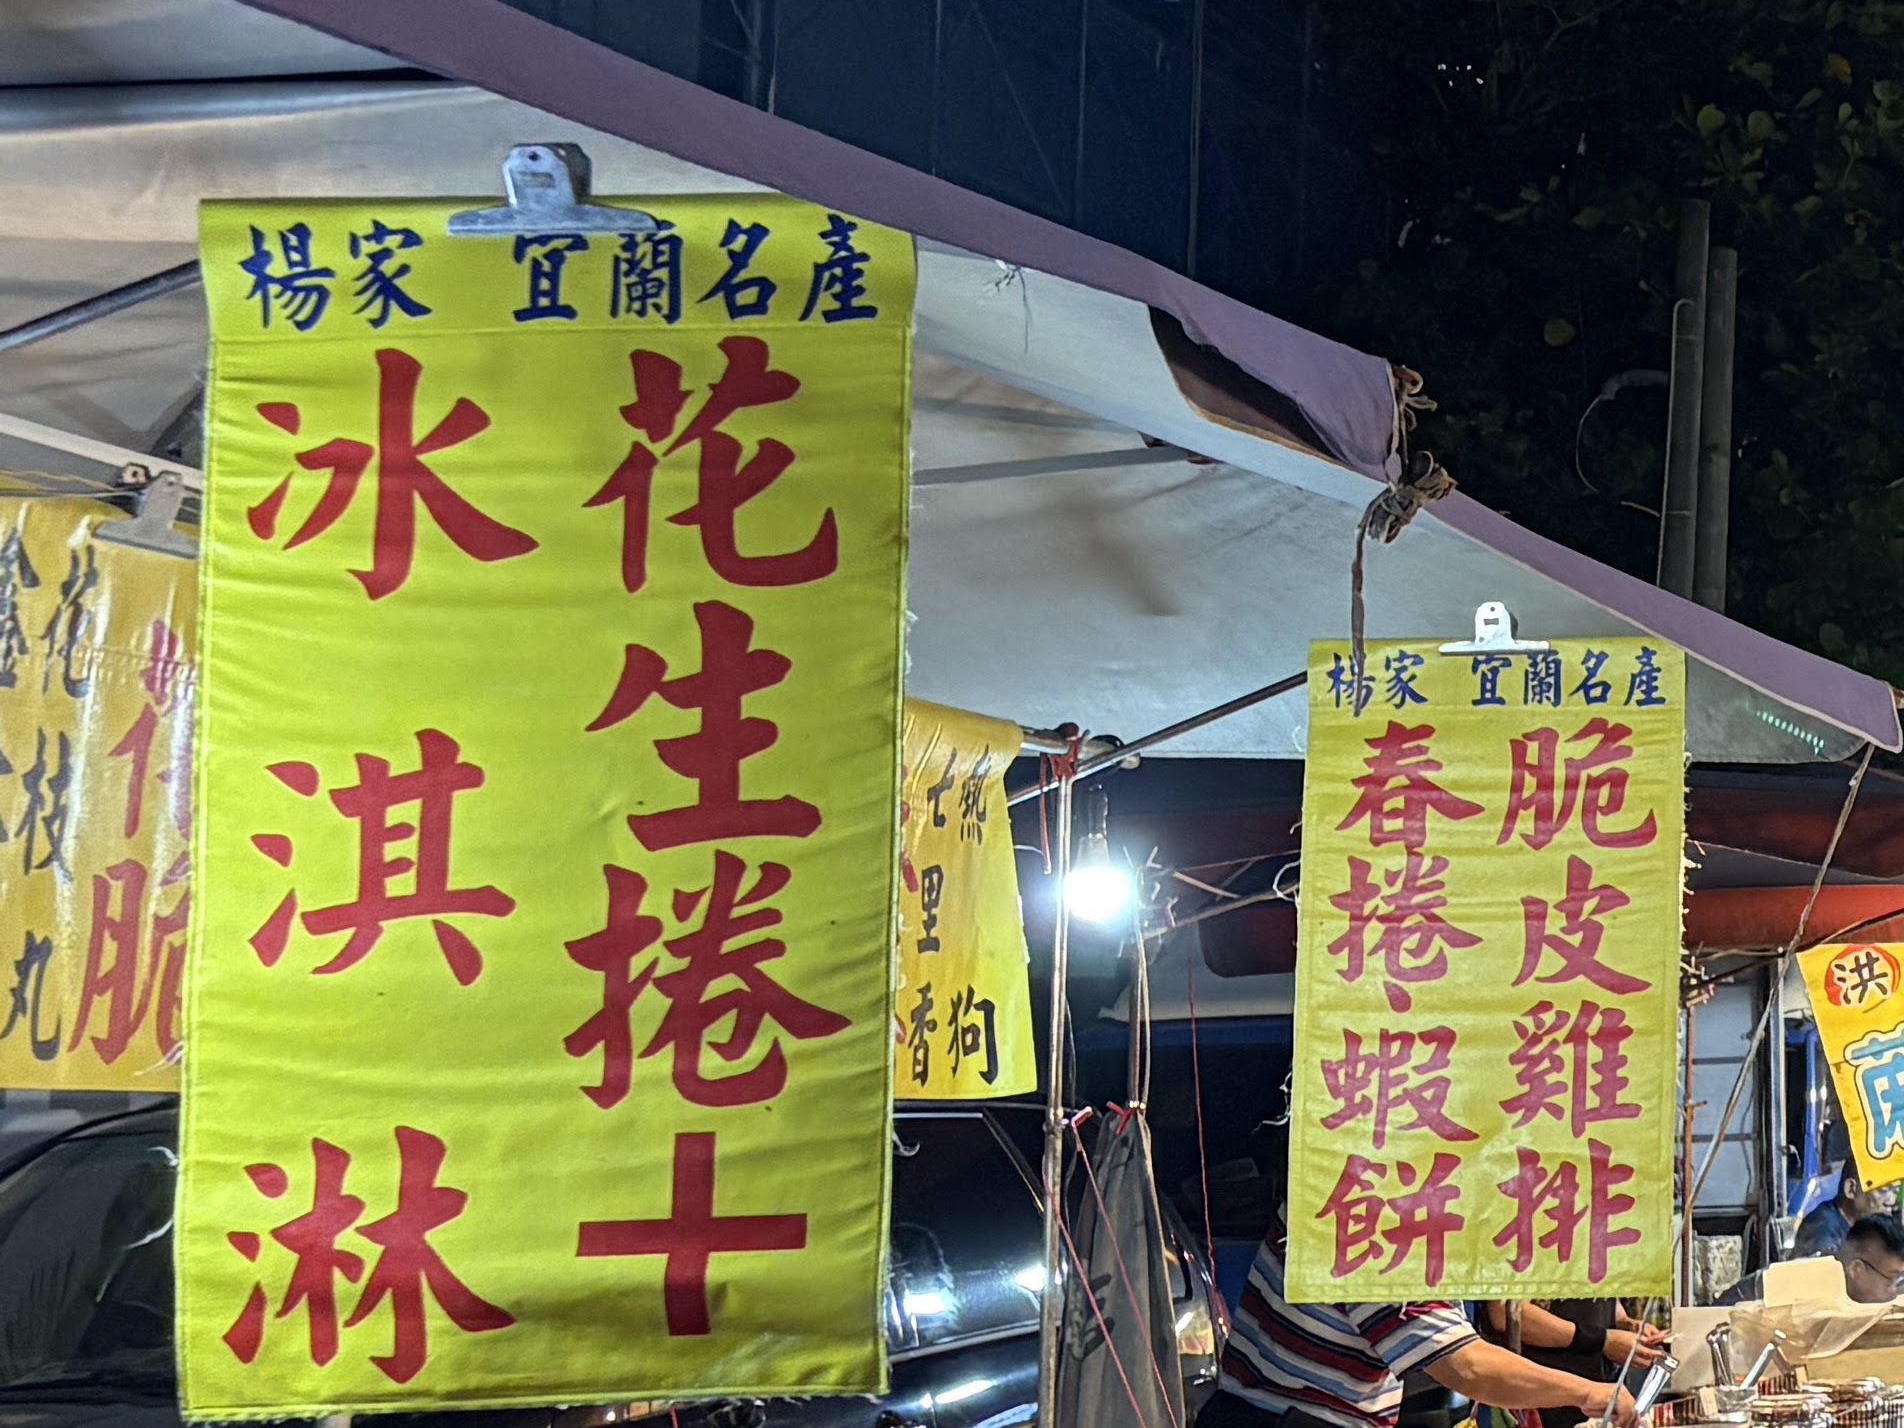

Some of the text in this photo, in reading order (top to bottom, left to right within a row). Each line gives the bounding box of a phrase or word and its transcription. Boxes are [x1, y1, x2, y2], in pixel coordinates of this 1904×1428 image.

[239, 216, 878, 334] 楊家 宜蘭名產
[1325, 647, 1667, 710] 楊家 宜蘭名產
[223, 348, 538, 1382] 冰淇淋
[908, 747, 956, 1088] 七里香
[947, 744, 998, 1086] 熱狗
[1494, 716, 1660, 1284] 脆皮雞排
[1835, 950, 1890, 1005] 洪
